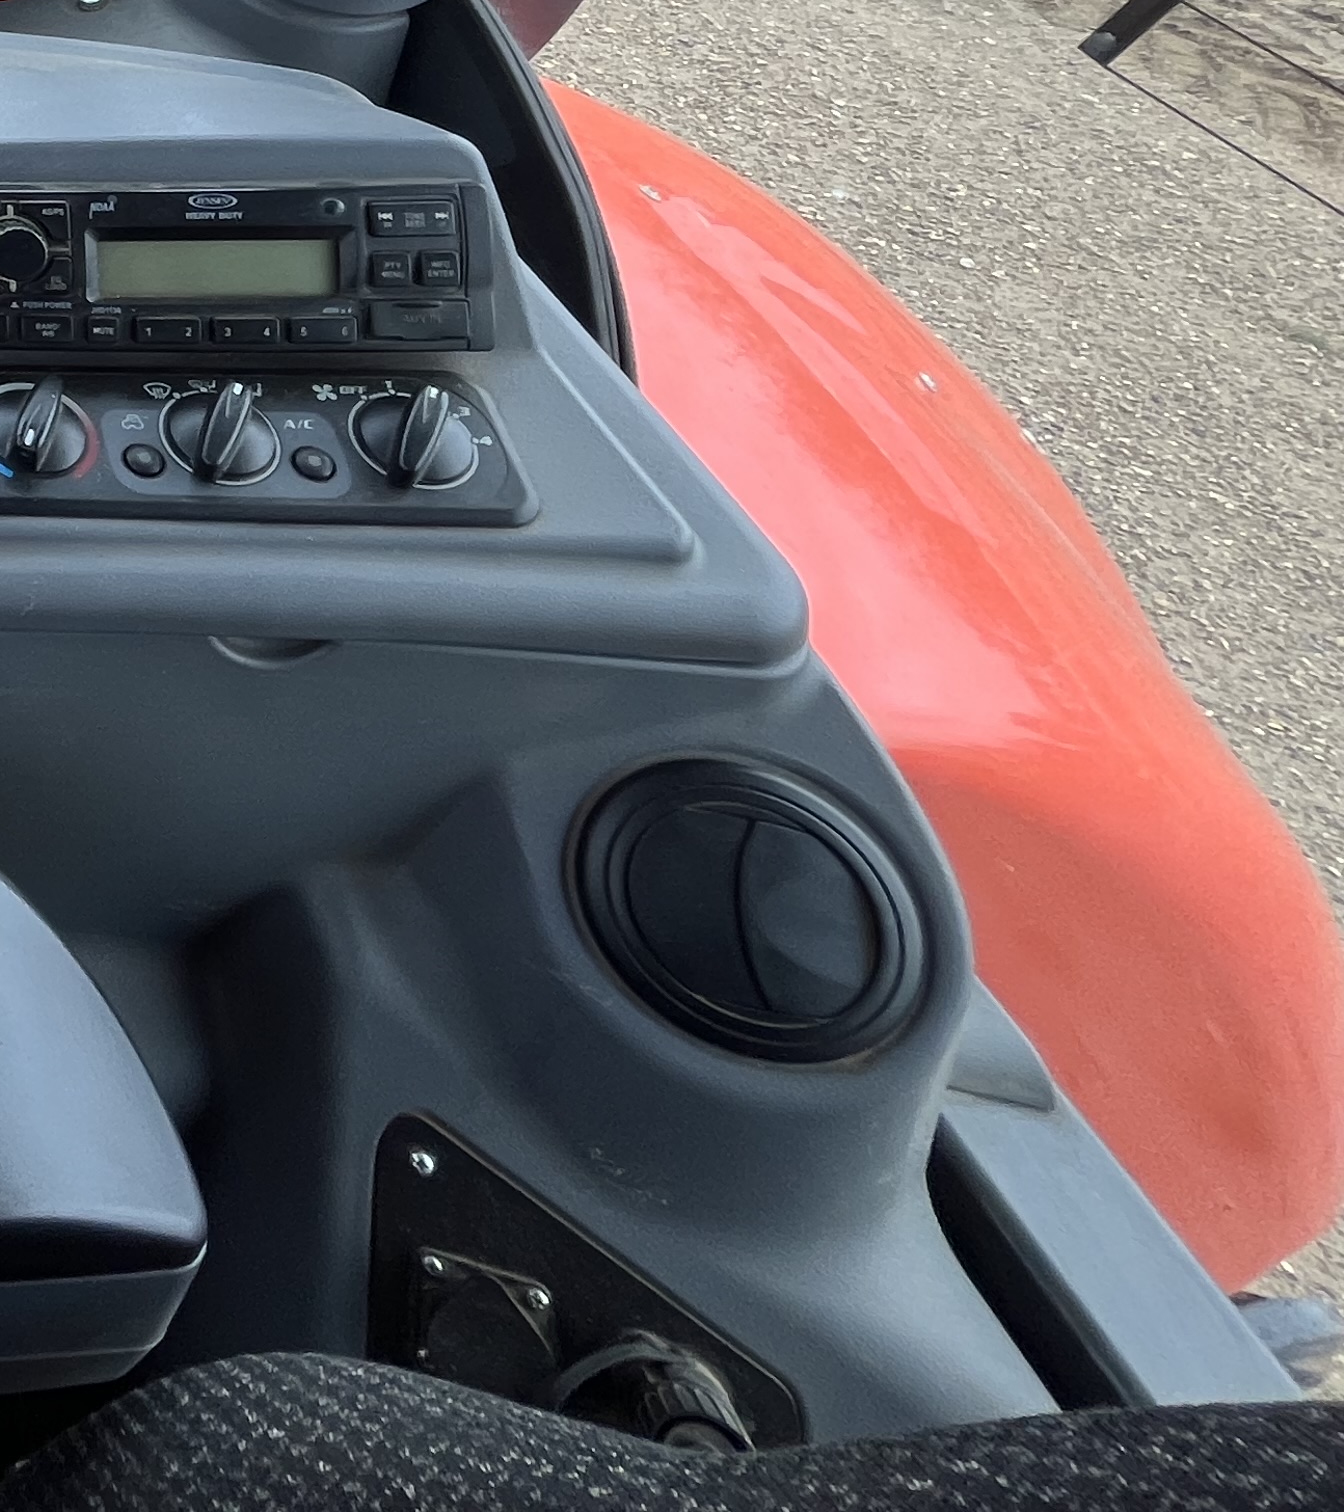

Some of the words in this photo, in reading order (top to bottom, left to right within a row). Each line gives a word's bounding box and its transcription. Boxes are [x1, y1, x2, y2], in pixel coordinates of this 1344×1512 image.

[185, 211, 216, 220] HEAVY
[218, 211, 244, 220] DUTY
[427, 269, 455, 278] ENTER
[22, 301, 44, 309] PUSH
[44, 301, 73, 310] POWER
[92, 327, 115, 336] MUTE
[339, 385, 367, 395] OFF
[283, 419, 315, 430] A/C
